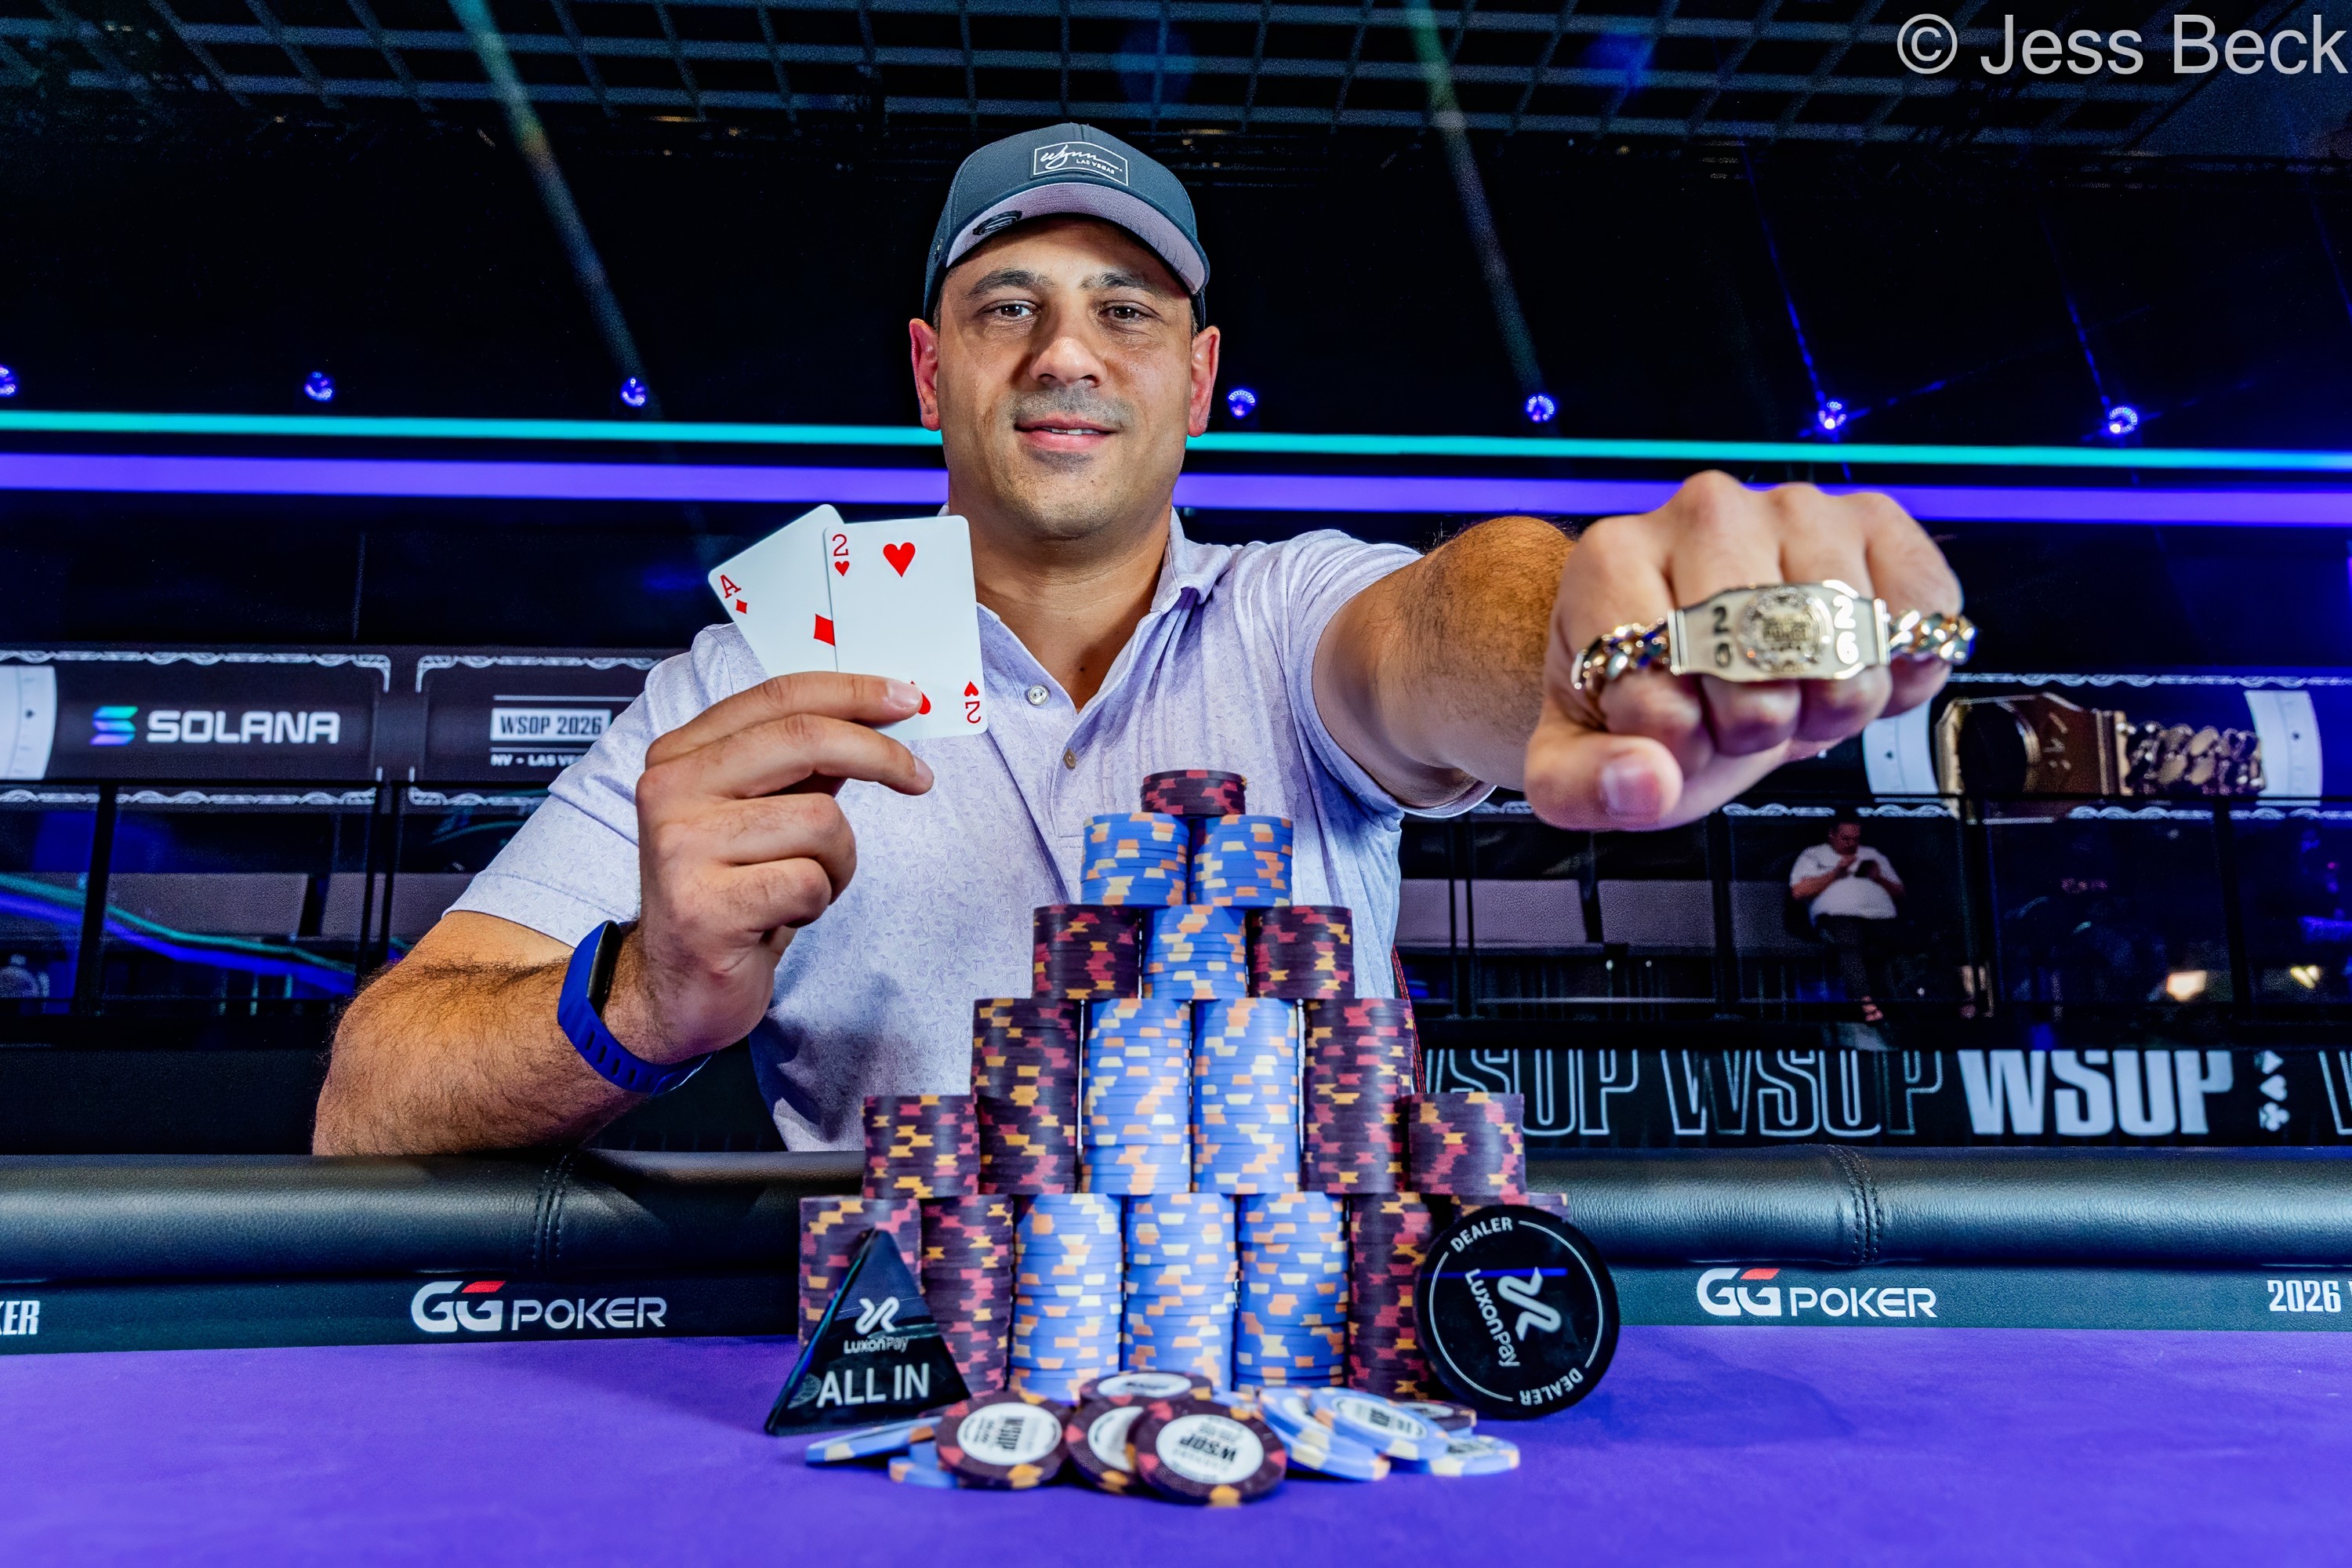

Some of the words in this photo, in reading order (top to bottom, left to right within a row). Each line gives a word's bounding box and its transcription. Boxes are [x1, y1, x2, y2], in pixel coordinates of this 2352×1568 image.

[1091, 161, 1115, 175] VEGAS
[832, 534, 849, 557] 2
[720, 575, 742, 598] A
[147, 710, 340, 744] SOLANA
[500, 716, 550, 735] WSOP
[557, 716, 602, 735] 2026
[964, 701, 982, 724] 2
[527, 754, 557, 767] LAS
[1661, 1049, 1944, 1135] WSOP
[1958, 1049, 2234, 1135] WSOP
[1450, 1217, 1513, 1252] DEALER
[1789, 1287, 1938, 1318] POKER
[2267, 1279, 2342, 1312] 2026
[511, 1297, 666, 1330] POKER
[816, 1367, 887, 1408] ALL
[894, 1363, 929, 1400] IN
[1519, 1367, 1584, 1406] DEALER
